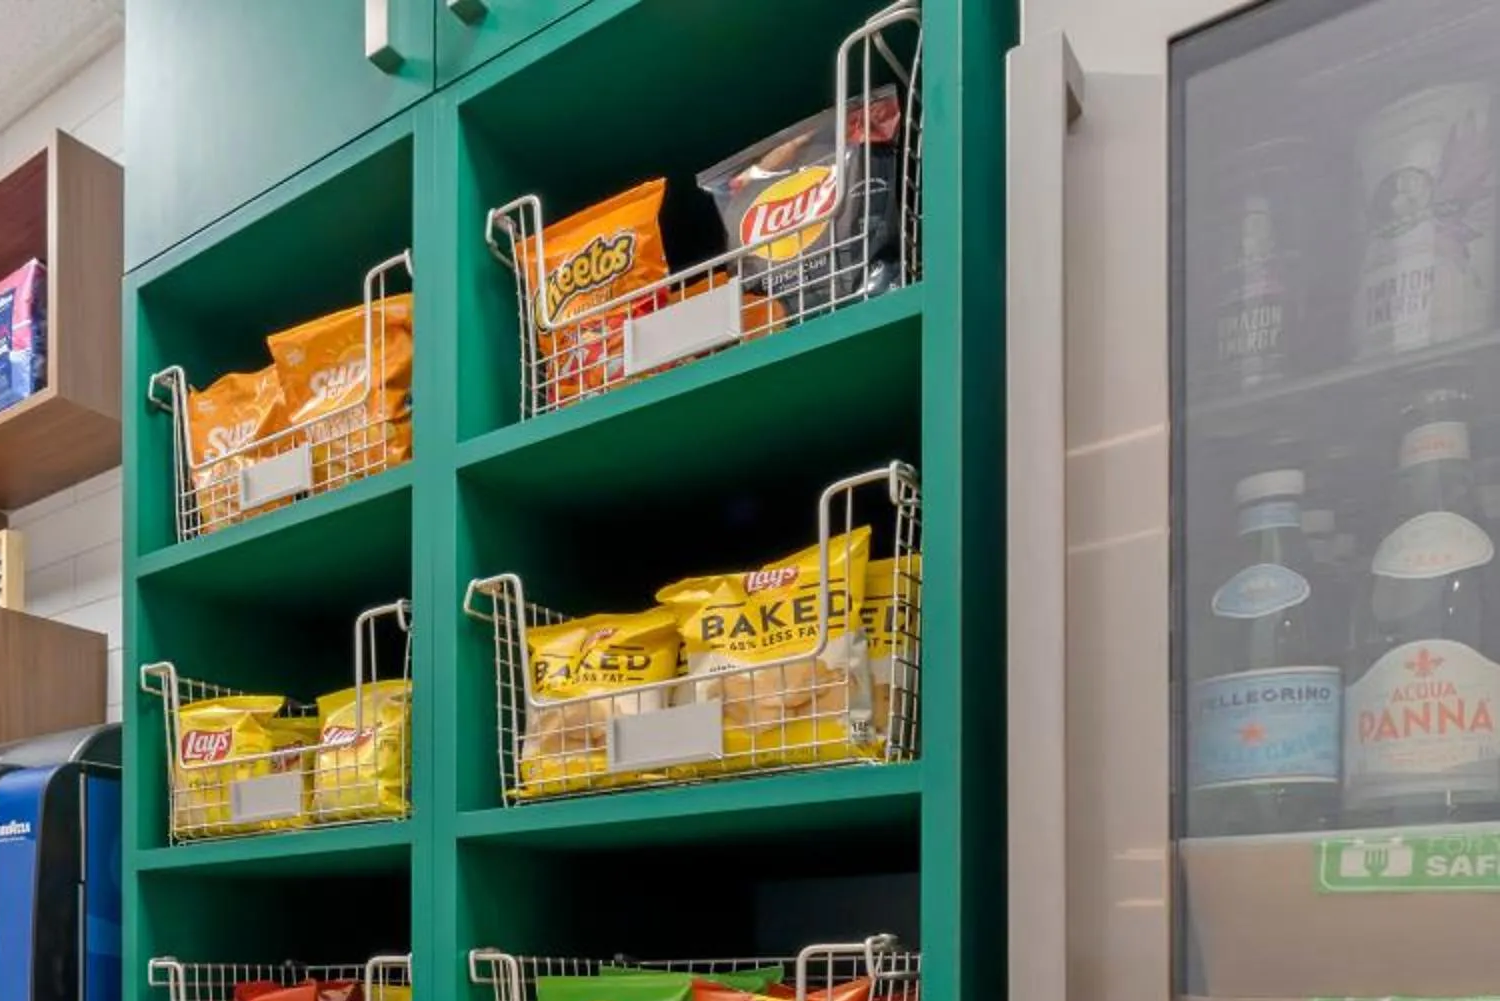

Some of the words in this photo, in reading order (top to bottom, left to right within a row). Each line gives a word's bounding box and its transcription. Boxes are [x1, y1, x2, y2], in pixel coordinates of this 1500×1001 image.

[702, 590, 853, 641] BAKED
[762, 630, 793, 647] LESS
[1358, 698, 1495, 744] PANNA
[1425, 854, 1500, 878] SAF
